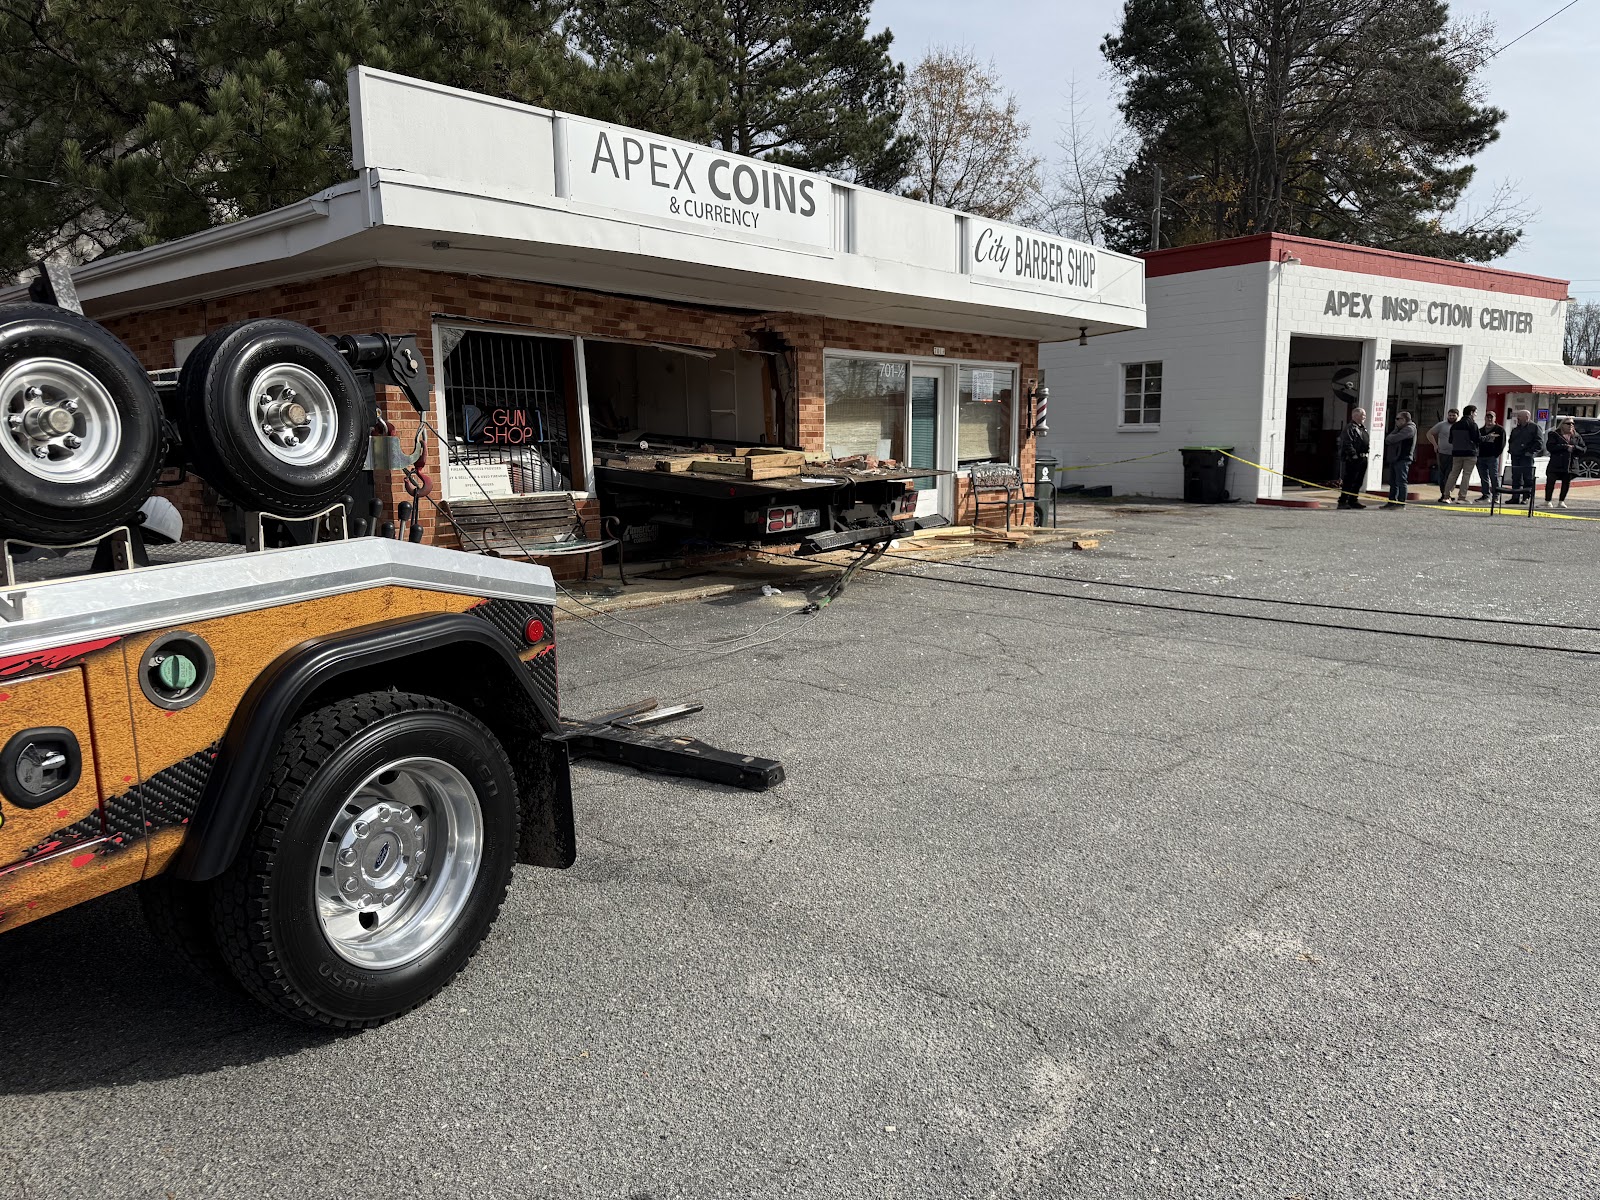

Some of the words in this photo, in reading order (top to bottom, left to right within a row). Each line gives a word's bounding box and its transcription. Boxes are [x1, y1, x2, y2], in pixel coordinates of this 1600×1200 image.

[591, 131, 696, 194] APEX
[708, 159, 816, 217] COINS
[669, 196, 680, 214] &
[684, 200, 760, 228] CURRENCY
[974, 228, 1011, 273] City
[1016, 235, 1063, 283] BARBER
[1068, 248, 1096, 288] SHOP
[1324, 290, 1373, 319] APEX
[1382, 296, 1473, 328] INSPCTION
[1480, 307, 1533, 334] CENTER
[483, 426, 533, 444] SHOP
[492, 408, 526, 427] GUN
